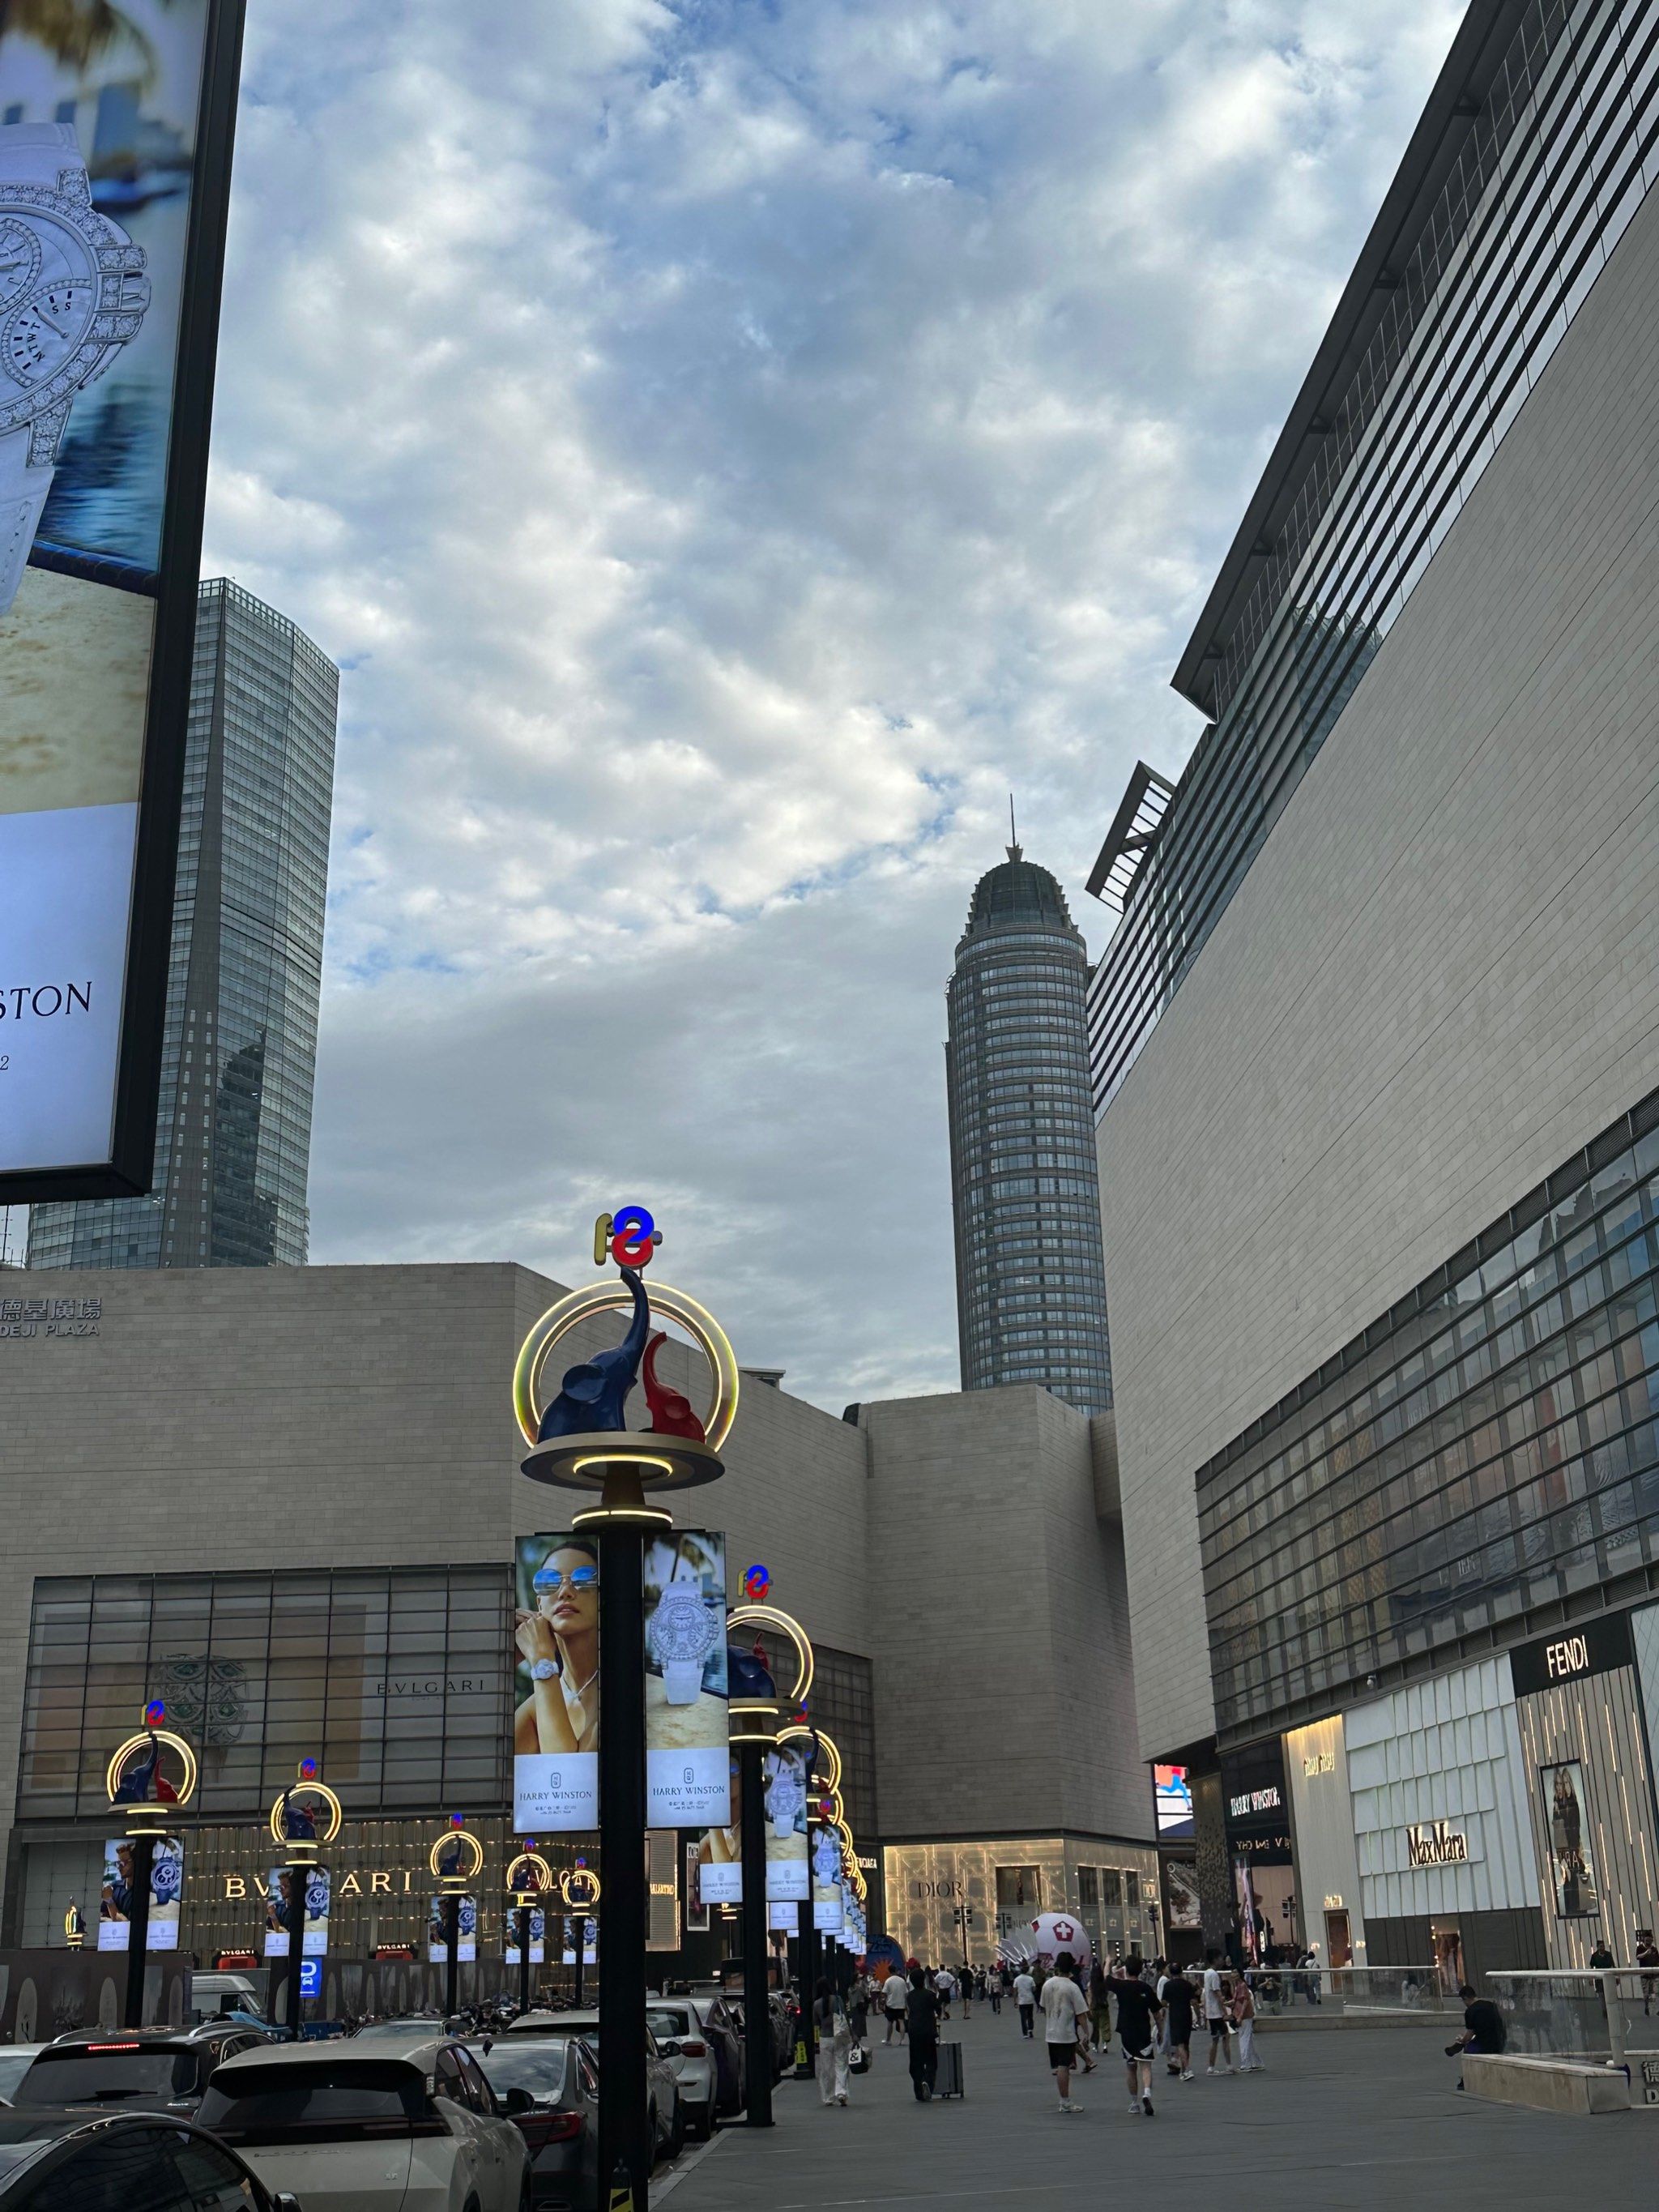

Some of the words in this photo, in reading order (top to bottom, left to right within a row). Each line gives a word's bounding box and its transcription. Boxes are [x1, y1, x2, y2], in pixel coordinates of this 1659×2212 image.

[0, 1323, 37, 1338] DEJI
[45, 1323, 100, 1338] PLAZA
[1546, 1634, 1589, 1679] FENDI
[377, 1680, 484, 1695] BVLGARI
[519, 1791, 549, 1801] HARRY
[552, 1790, 592, 1800] WINSTON
[653, 1787, 682, 1796] HARRY
[685, 1785, 725, 1795] WINSTON
[918, 1881, 963, 1898] DIOR
